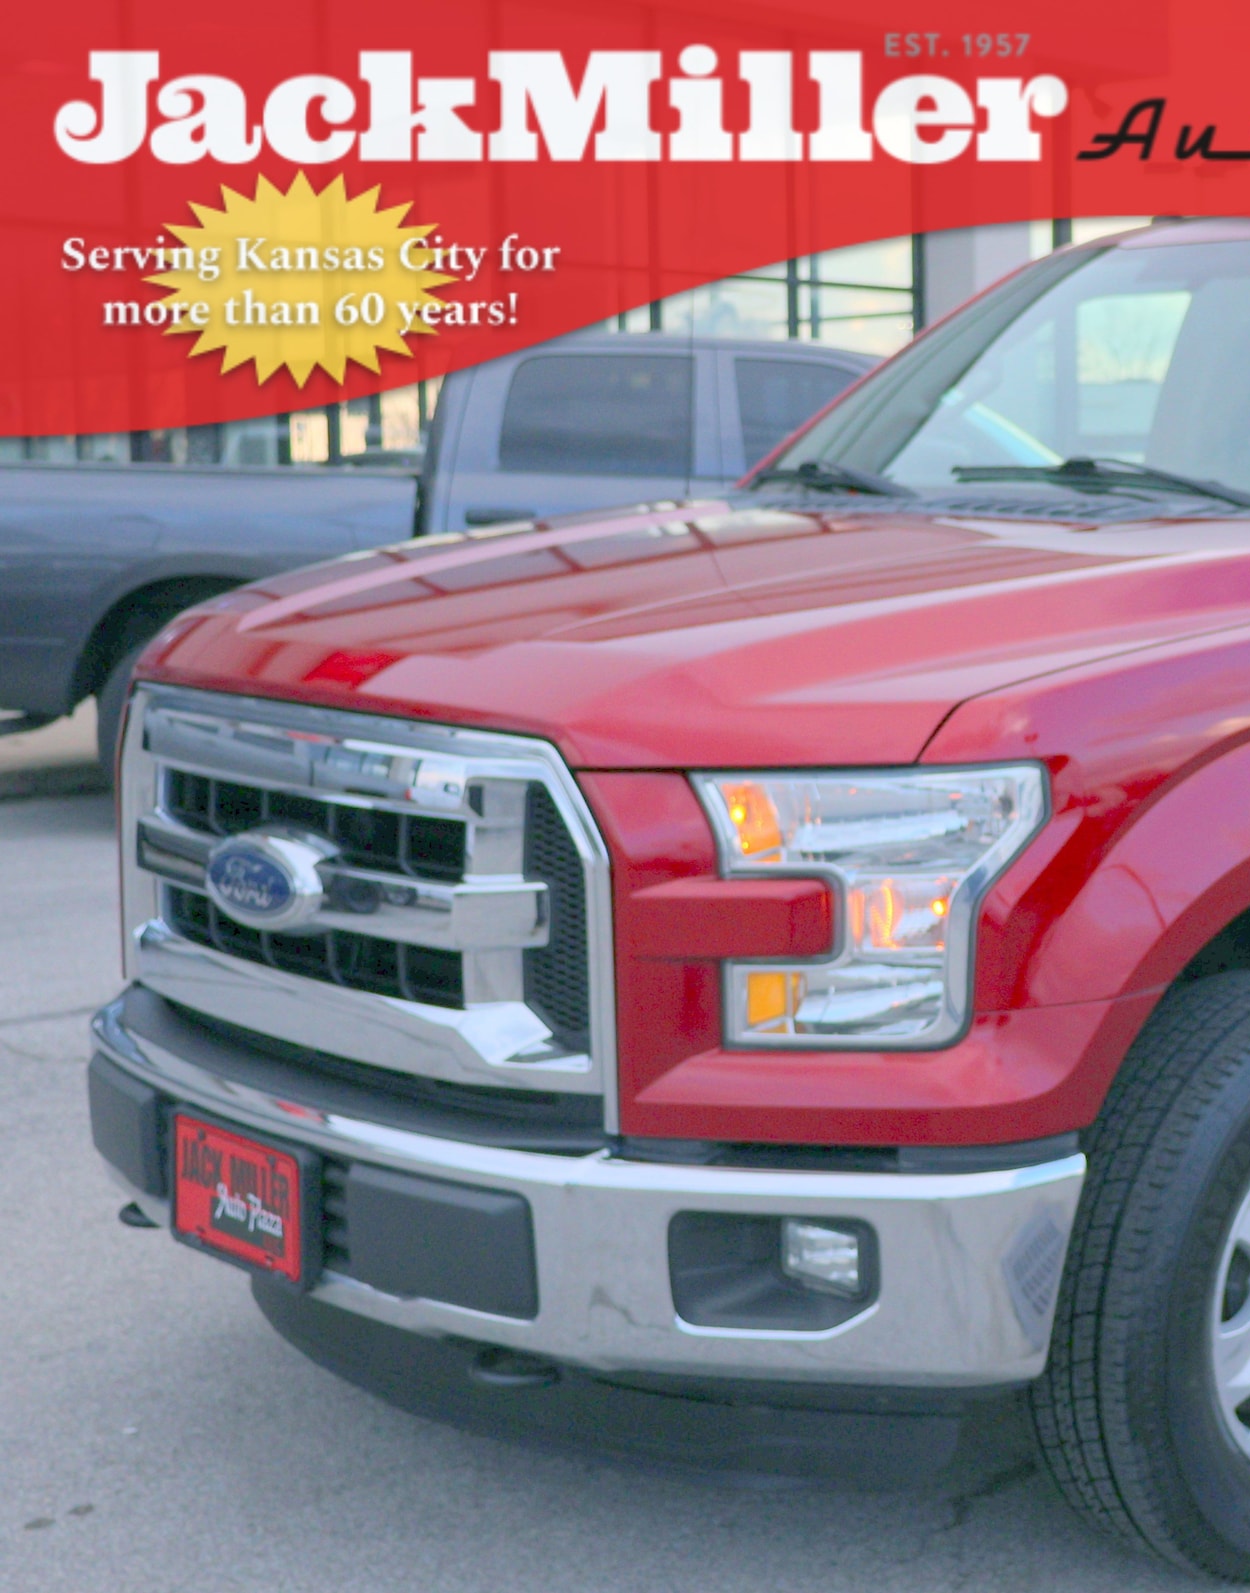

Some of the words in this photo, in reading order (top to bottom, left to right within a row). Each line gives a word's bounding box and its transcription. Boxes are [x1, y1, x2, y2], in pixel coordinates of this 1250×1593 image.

[217, 858, 276, 908] Ford
[181, 1137, 224, 1190] JACK
[229, 1153, 291, 1221] MILLER
[214, 1182, 247, 1220] Auto
[246, 1192, 284, 1238] Plaza
